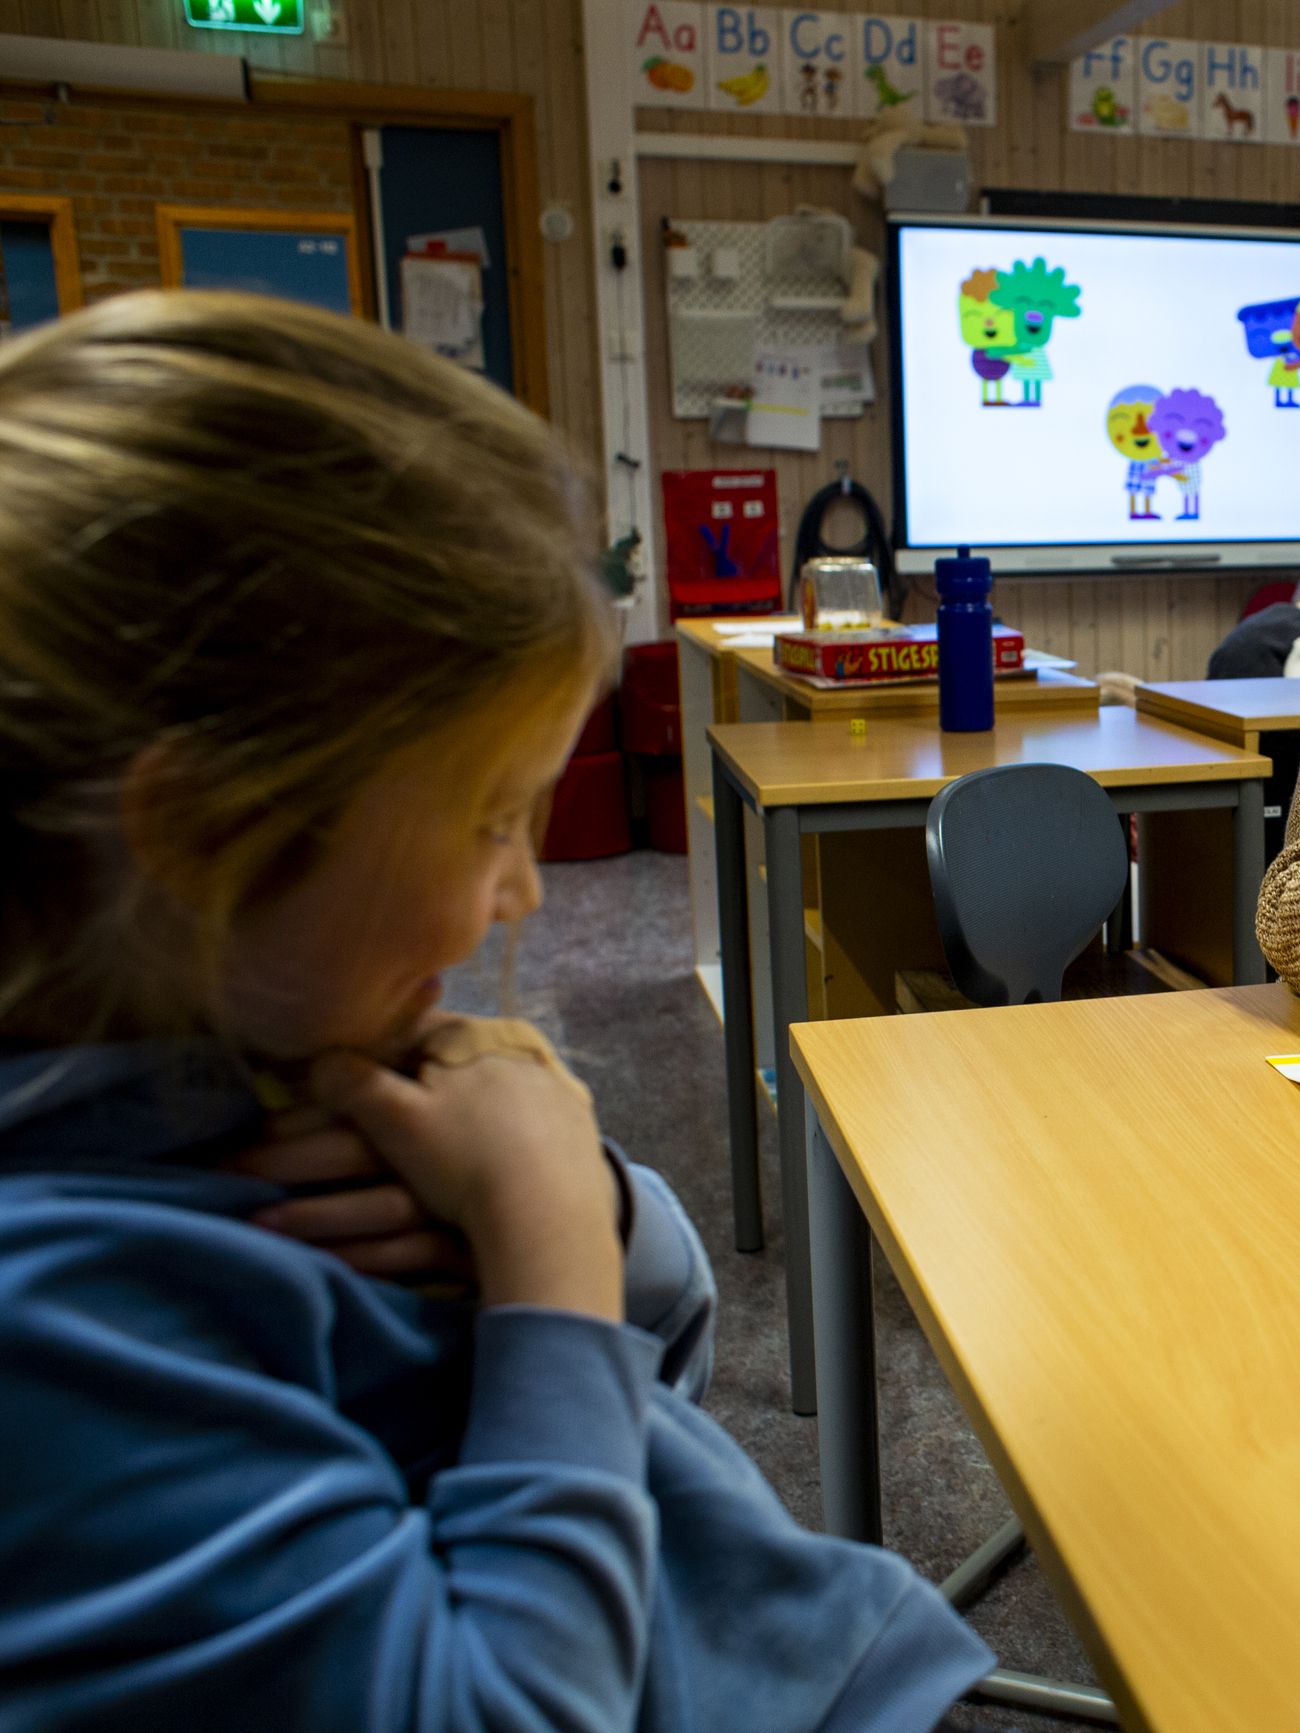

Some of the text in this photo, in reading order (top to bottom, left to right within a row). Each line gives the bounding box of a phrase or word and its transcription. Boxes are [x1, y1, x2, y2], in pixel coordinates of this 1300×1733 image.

[636, 4, 985, 72] Aa Bb Cc Dd Ee
[1142, 40, 1195, 102] Gg
[1206, 46, 1259, 89] Hh
